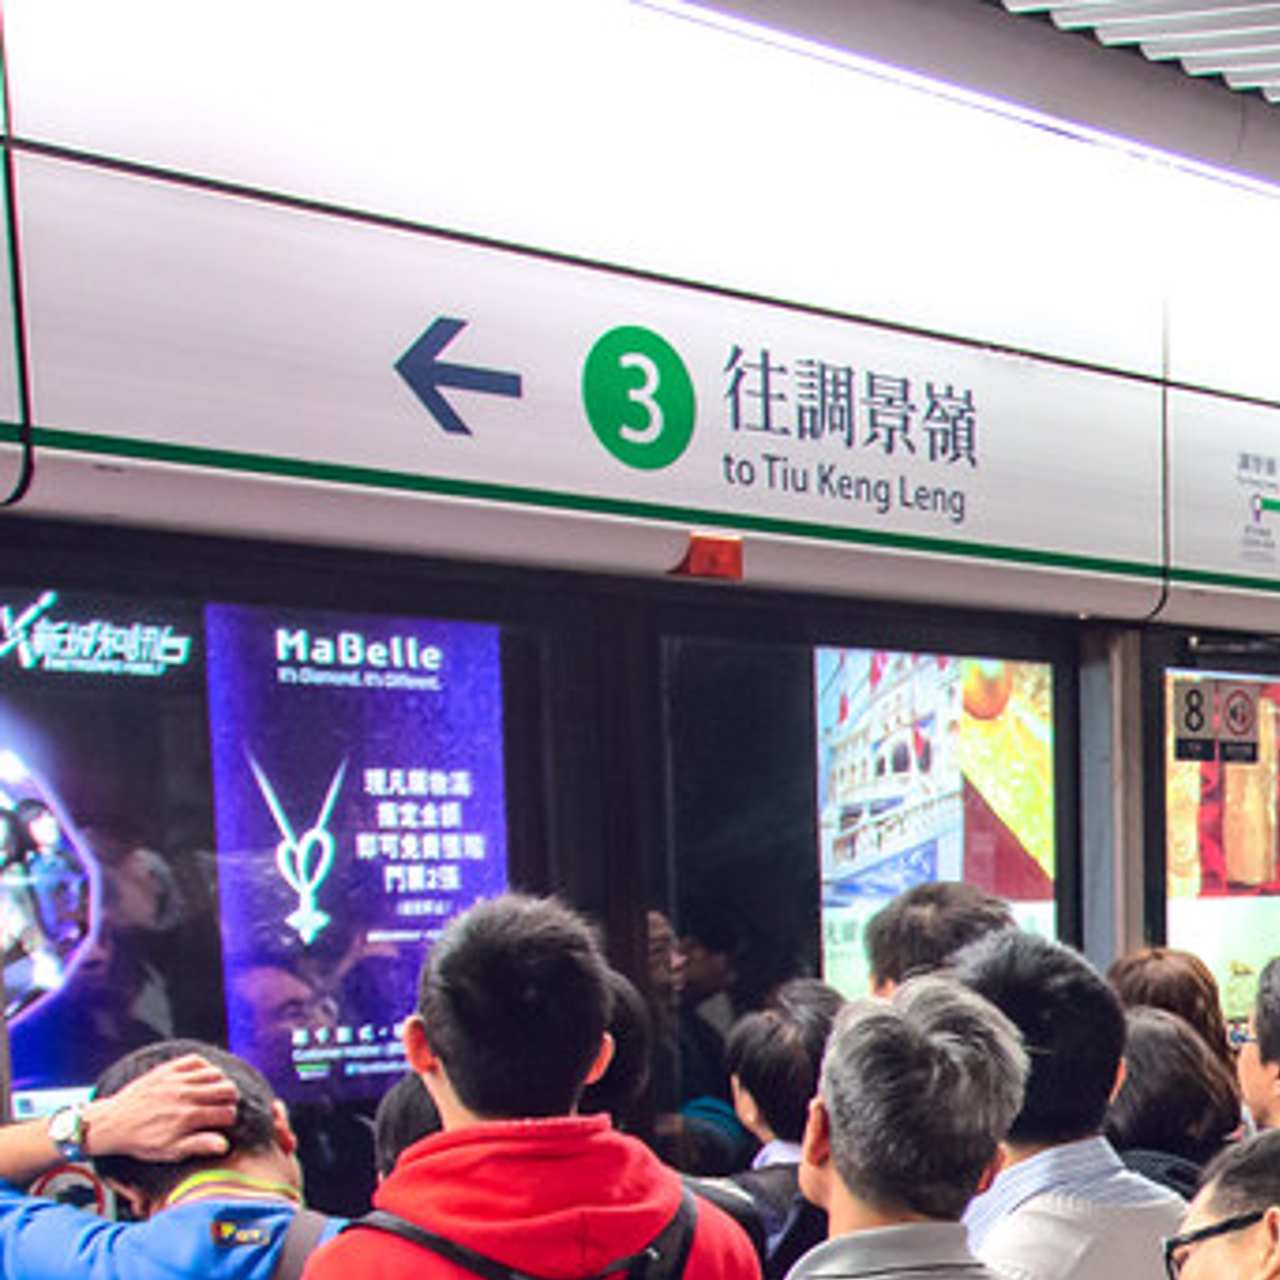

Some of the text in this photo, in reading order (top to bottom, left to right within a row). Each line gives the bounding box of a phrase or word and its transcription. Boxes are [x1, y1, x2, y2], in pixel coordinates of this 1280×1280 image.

[618, 352, 665, 444] 3
[723, 344, 977, 467] 往調景嶺
[722, 452, 966, 524] to Tiu Keng Leng
[276, 628, 443, 671] MaBelle
[1184, 688, 1205, 732] 8
